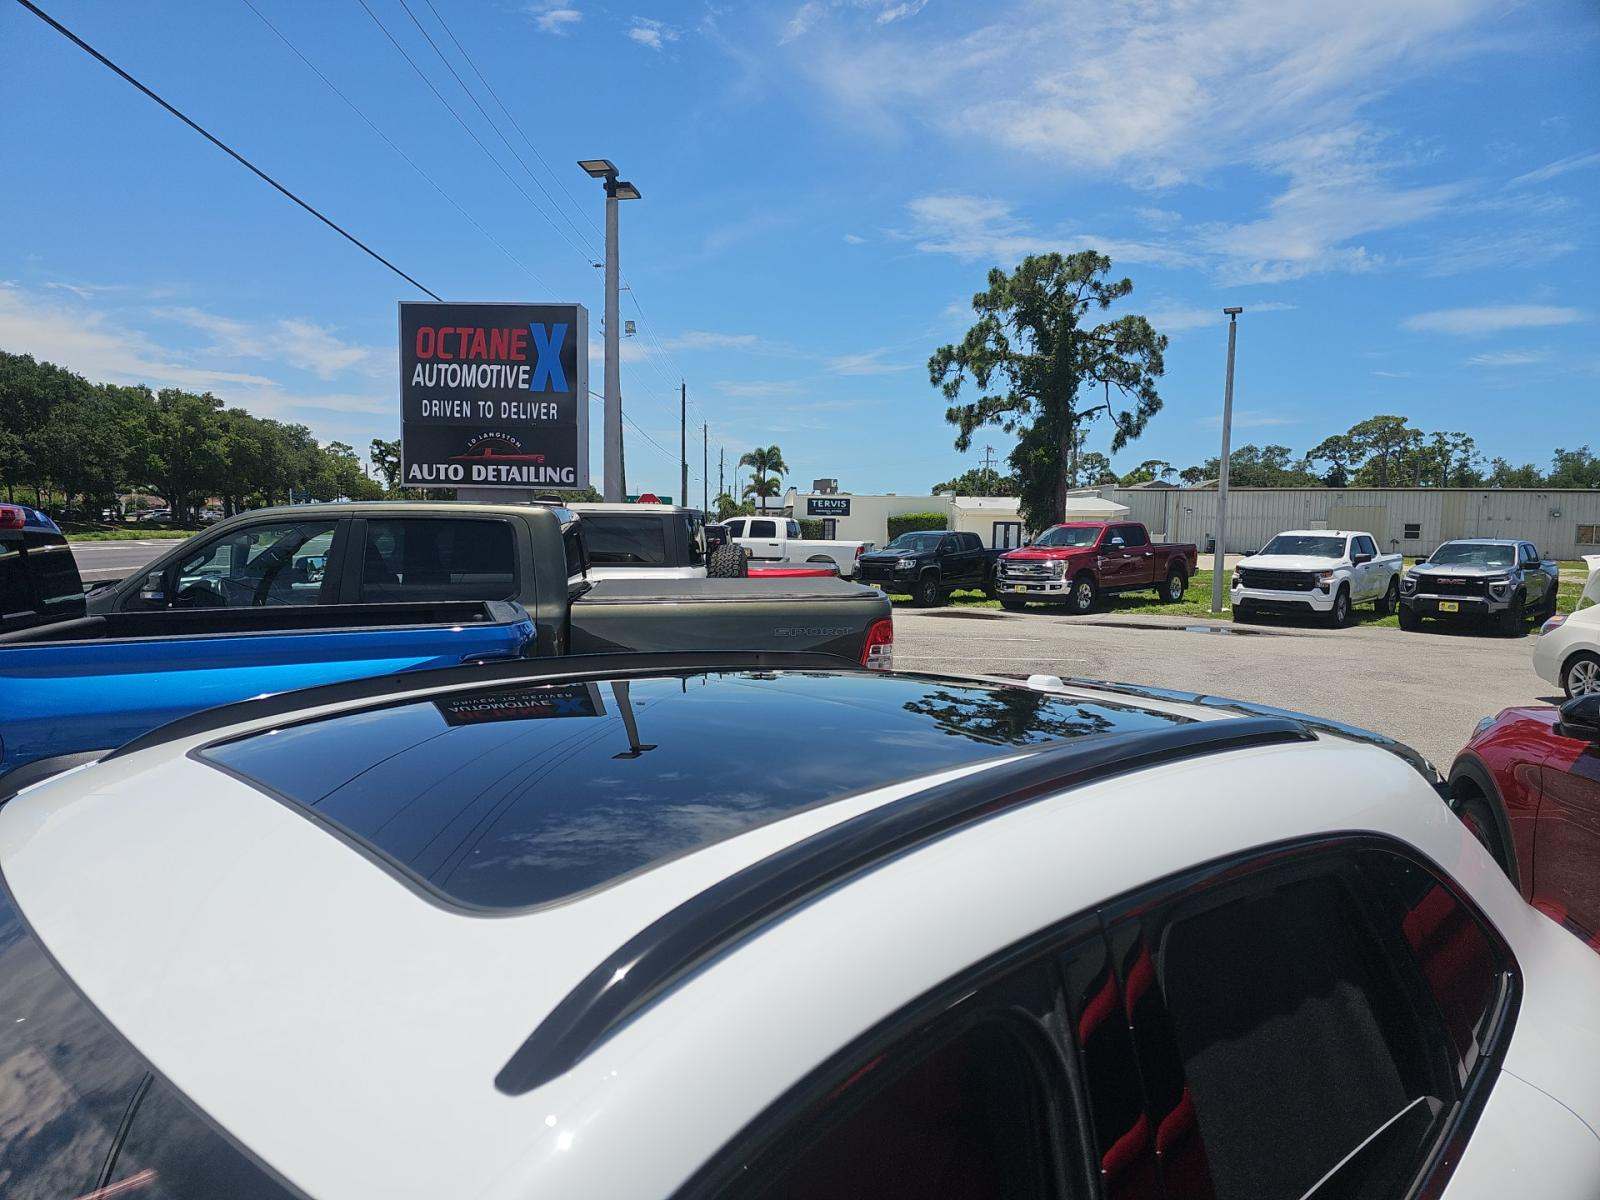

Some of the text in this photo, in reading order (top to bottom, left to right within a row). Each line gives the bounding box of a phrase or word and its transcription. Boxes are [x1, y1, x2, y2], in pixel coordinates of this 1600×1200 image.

[416, 323, 569, 393] OCTANE X
[412, 363, 530, 389] AUTOMOTIVE
[422, 400, 558, 420] DRIVEN TO DELIVER
[478, 432, 522, 448] LANGSTON
[409, 463, 575, 483] AUTO DETAILING
[811, 499, 847, 508] TERVIS
